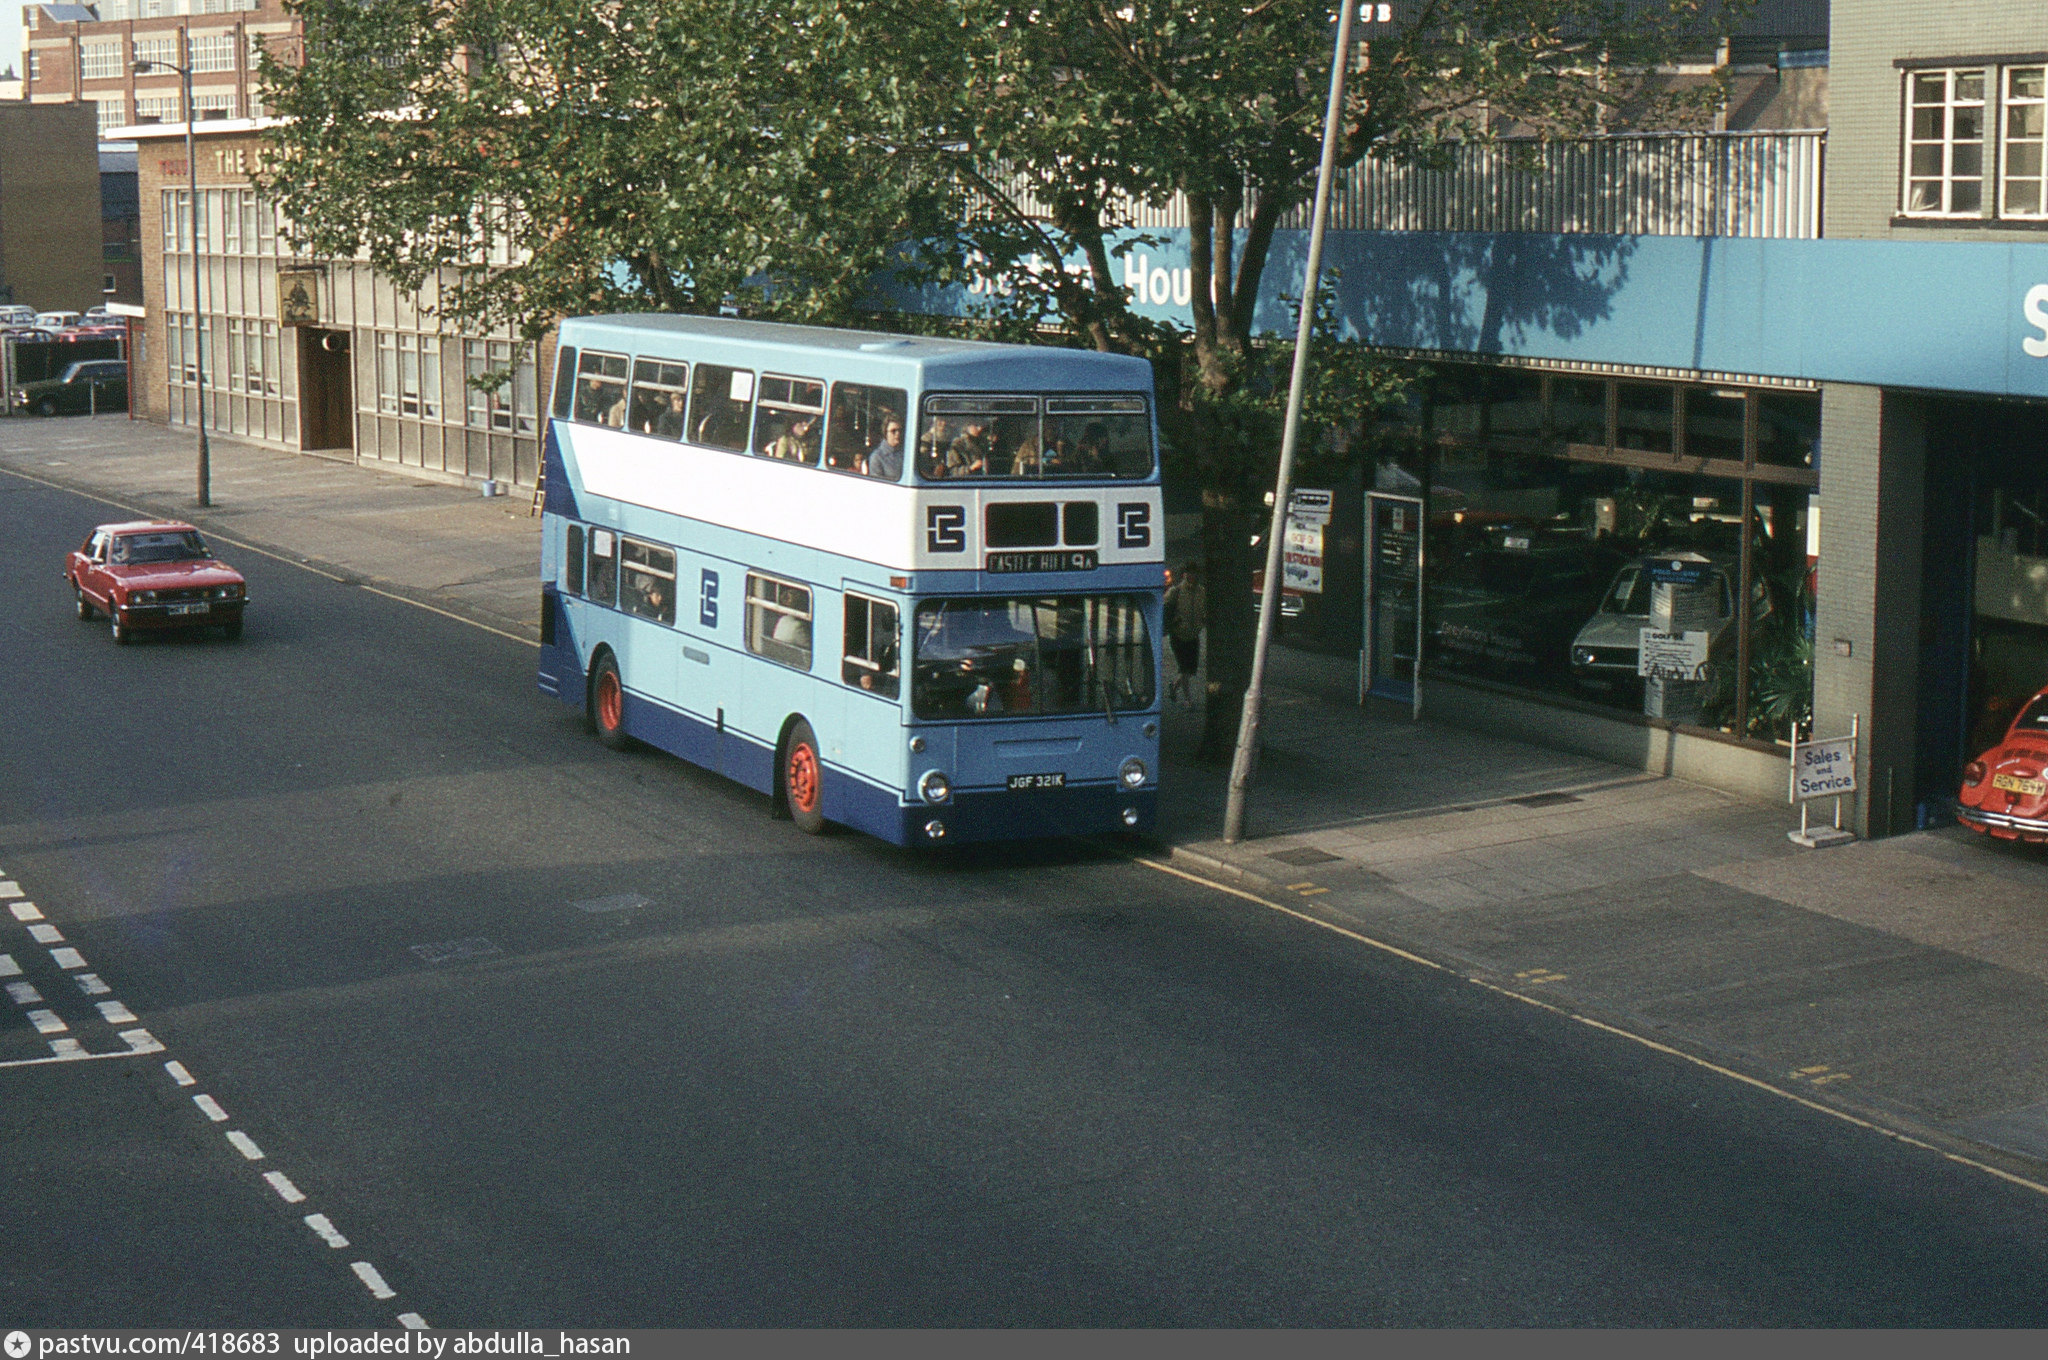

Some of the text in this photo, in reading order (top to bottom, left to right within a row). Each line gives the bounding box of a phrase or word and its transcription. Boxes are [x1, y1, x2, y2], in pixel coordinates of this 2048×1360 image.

[215, 149, 245, 174] THE
[1124, 253, 1216, 306] Hou
[1040, 553, 1067, 571] HILL
[1804, 748, 1841, 766] Sales
[1816, 765, 1833, 775] and
[1009, 774, 1064, 789] JGF 321K
[1800, 775, 1852, 793] Service
